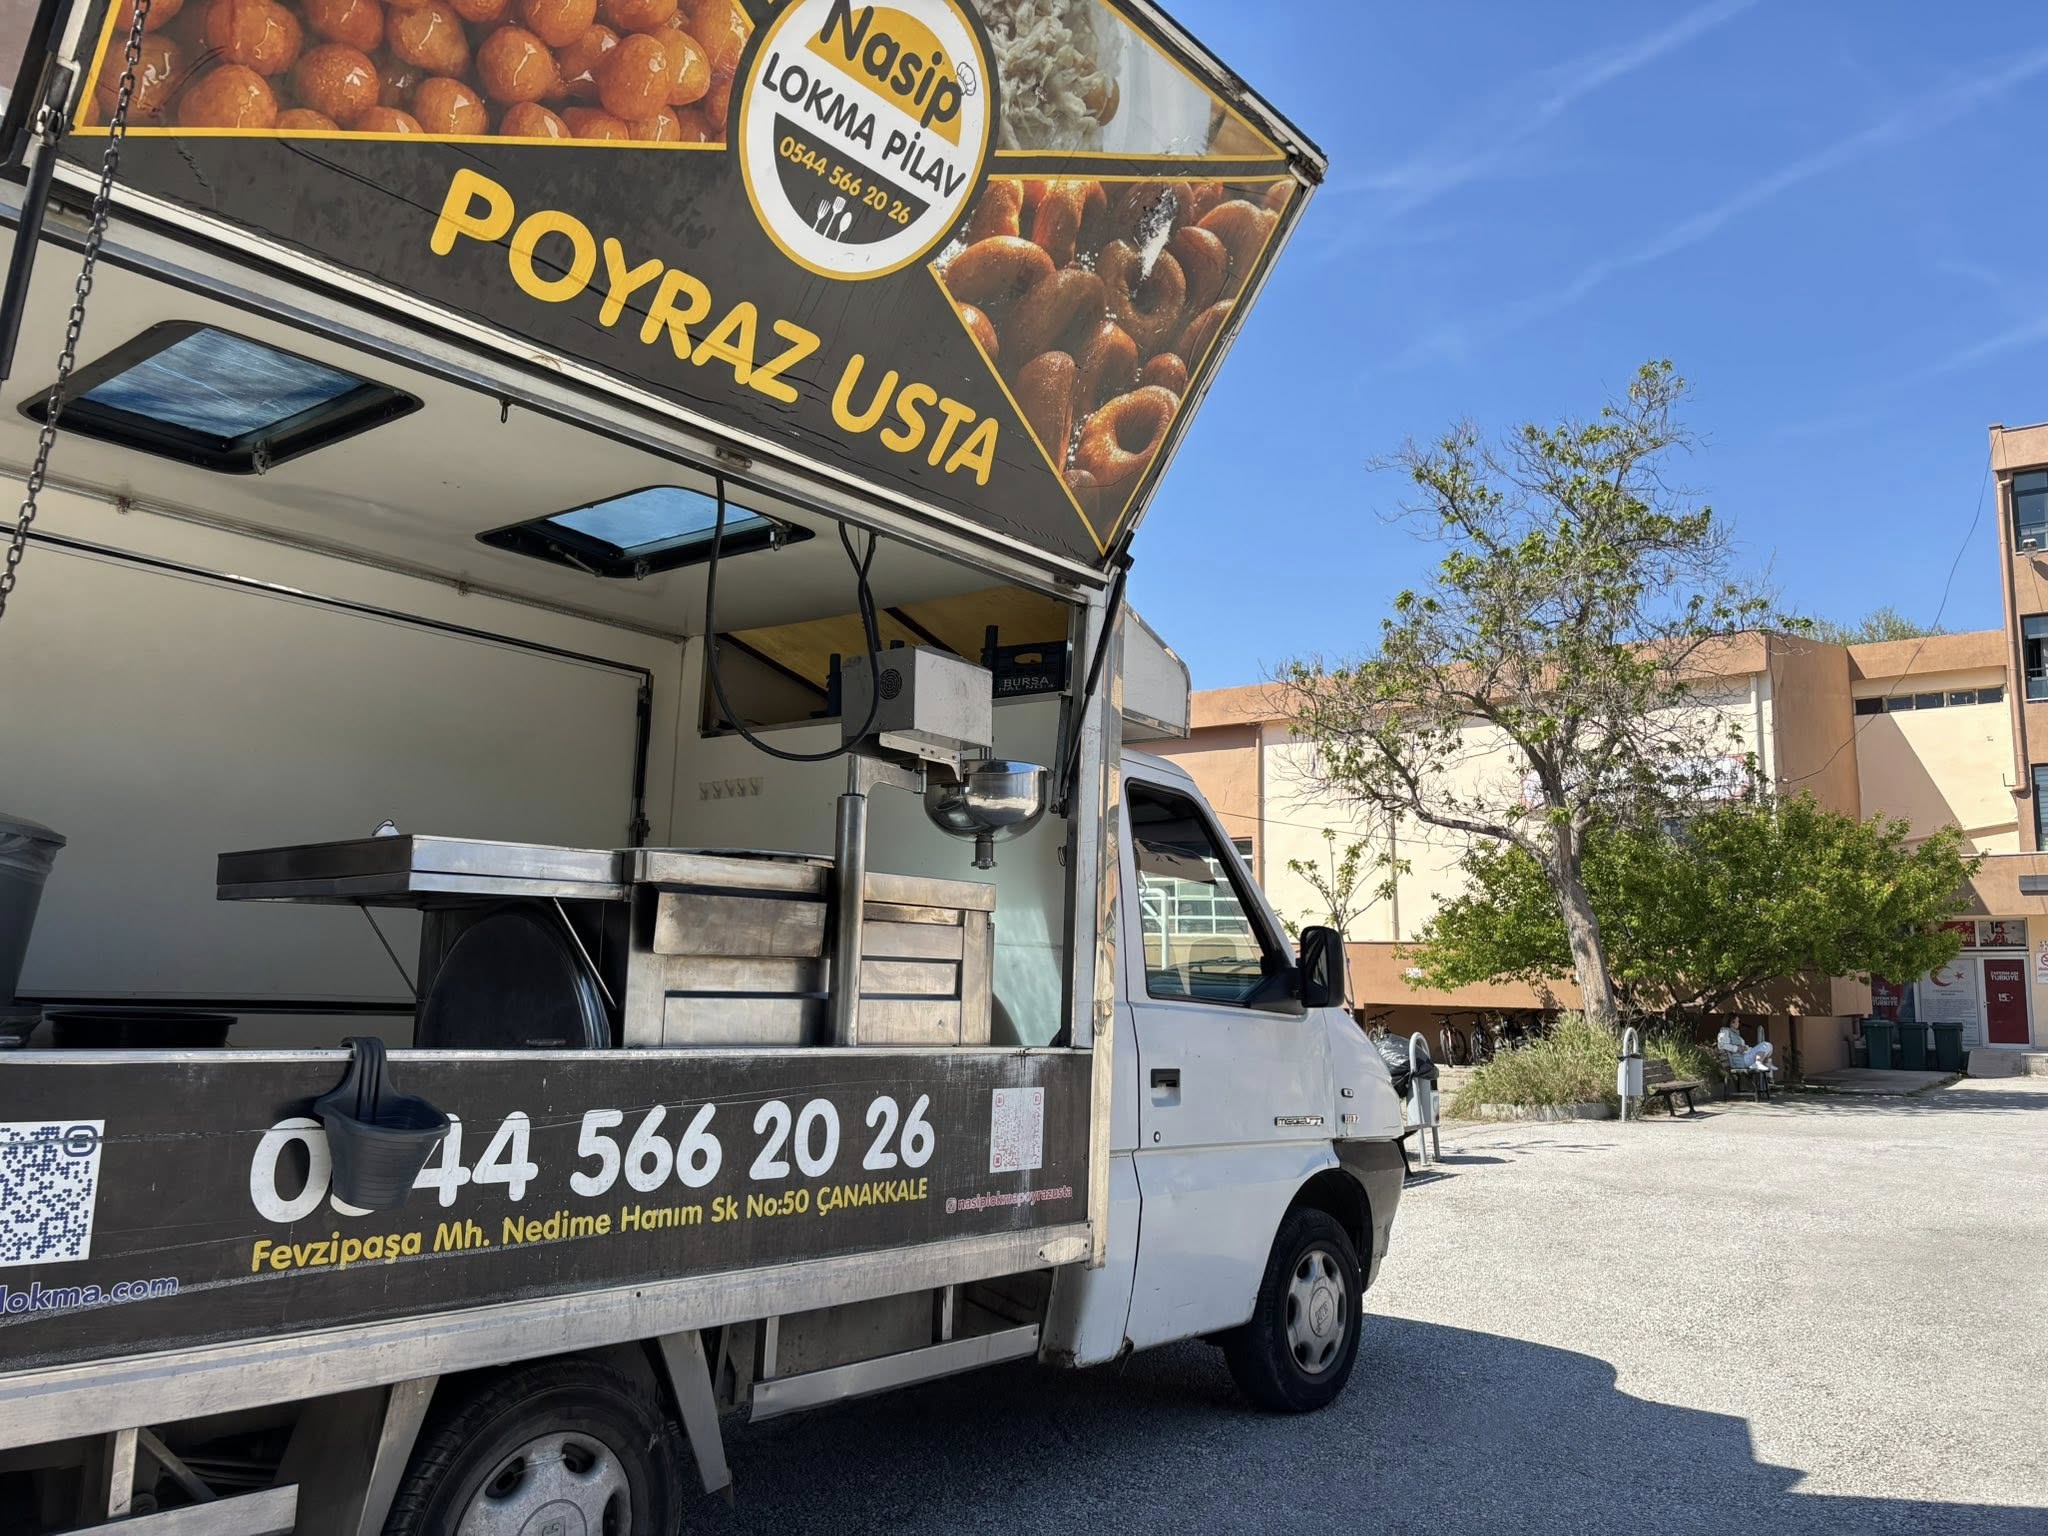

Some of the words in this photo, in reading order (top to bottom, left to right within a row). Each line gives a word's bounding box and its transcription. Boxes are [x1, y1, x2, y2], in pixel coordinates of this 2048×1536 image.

[819, 0, 962, 128] Nasip
[762, 52, 875, 150] LOKMA
[882, 131, 966, 198] PİLAV
[780, 137, 826, 176] 0544
[828, 166, 860, 197] 566
[862, 187, 888, 211] 20
[888, 200, 910, 224] 26
[430, 168, 820, 403] POYRAZ
[831, 354, 1000, 486] USTA
[1003, 676, 1049, 688] BURSA
[250, 1111, 538, 1223] 044
[570, 1103, 722, 1197] 566
[749, 1098, 840, 1180] 20
[863, 1094, 935, 1170] 26
[957, 1185, 1073, 1212] nasiplokmapoyrazusta
[252, 1231, 421, 1272] Fevzipaşa
[433, 1219, 490, 1252] Mh.
[502, 1210, 611, 1244] Nedime
[621, 1204, 703, 1232] Hanım
[711, 1195, 738, 1222] Sk
[746, 1189, 810, 1219] No:50
[816, 1177, 928, 1216] ÇANAKKALE
